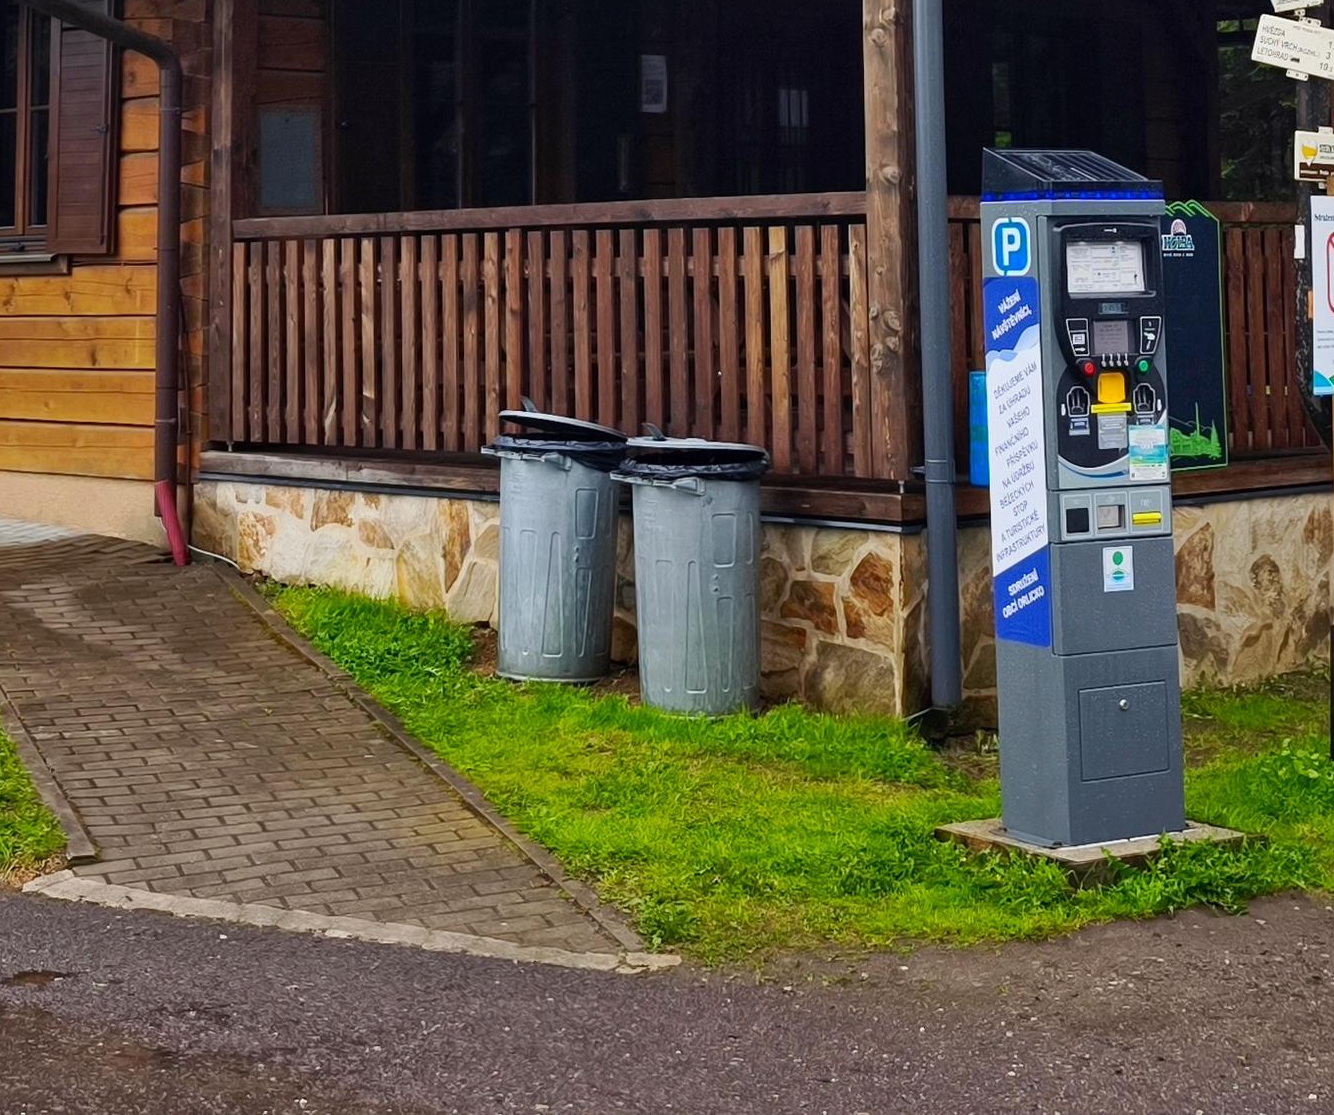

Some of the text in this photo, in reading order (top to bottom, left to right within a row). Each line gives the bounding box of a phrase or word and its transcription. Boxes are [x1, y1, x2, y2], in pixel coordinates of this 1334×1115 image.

[1001, 227, 1021, 266] P
[997, 288, 1022, 315] VÁŽENÍ
[993, 360, 1038, 400] DĚKUJEME VÁM
[1001, 479, 1011, 490] NA
[1005, 508, 1040, 538] TURISTICKÉ
[1012, 499, 1028, 517] STOP
[996, 523, 1045, 563] INFRASTRUKTURY
[1007, 567, 1040, 597] SDRUŽENÍ
[1002, 585, 1046, 619] OBCÍ ORLICKO
